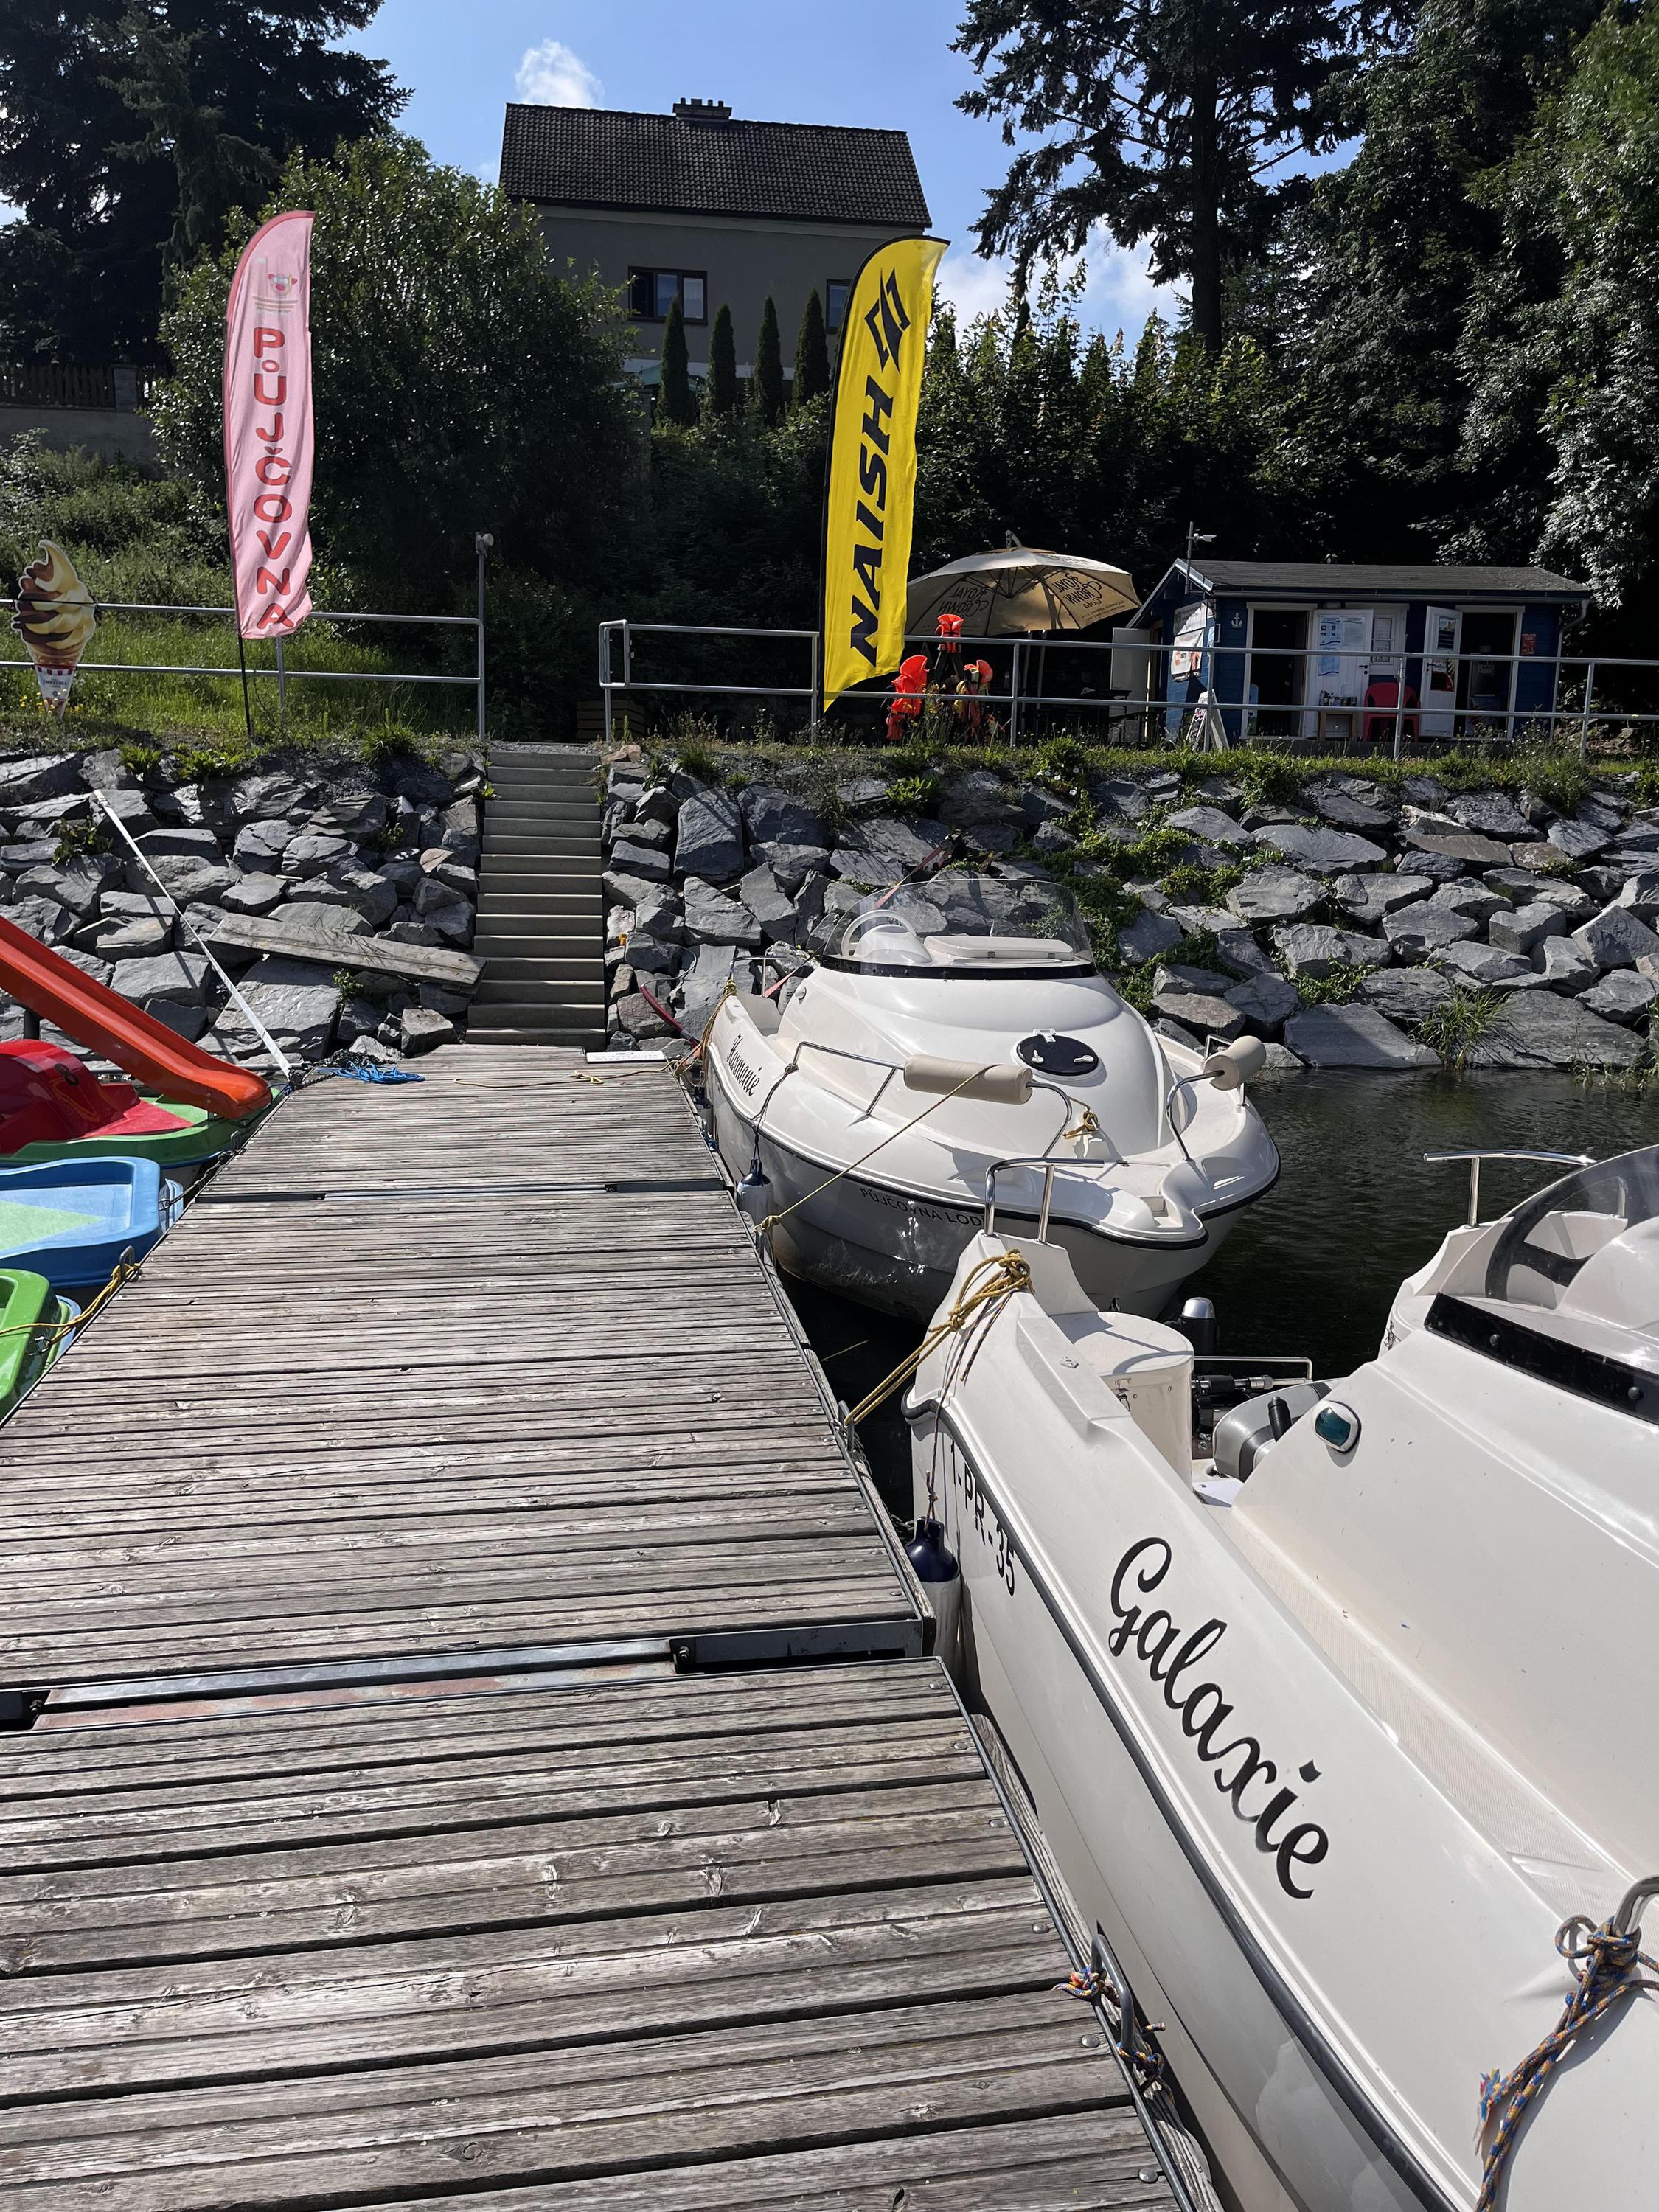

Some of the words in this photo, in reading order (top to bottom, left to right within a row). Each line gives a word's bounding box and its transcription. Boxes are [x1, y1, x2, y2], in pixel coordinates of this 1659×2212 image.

[252, 327, 294, 630] PŮJČOVNA
[850, 375, 894, 667] NAISH
[860, 1187, 942, 1221] PŮJČOVNA
[1108, 1537, 1329, 1899] Galaxie
